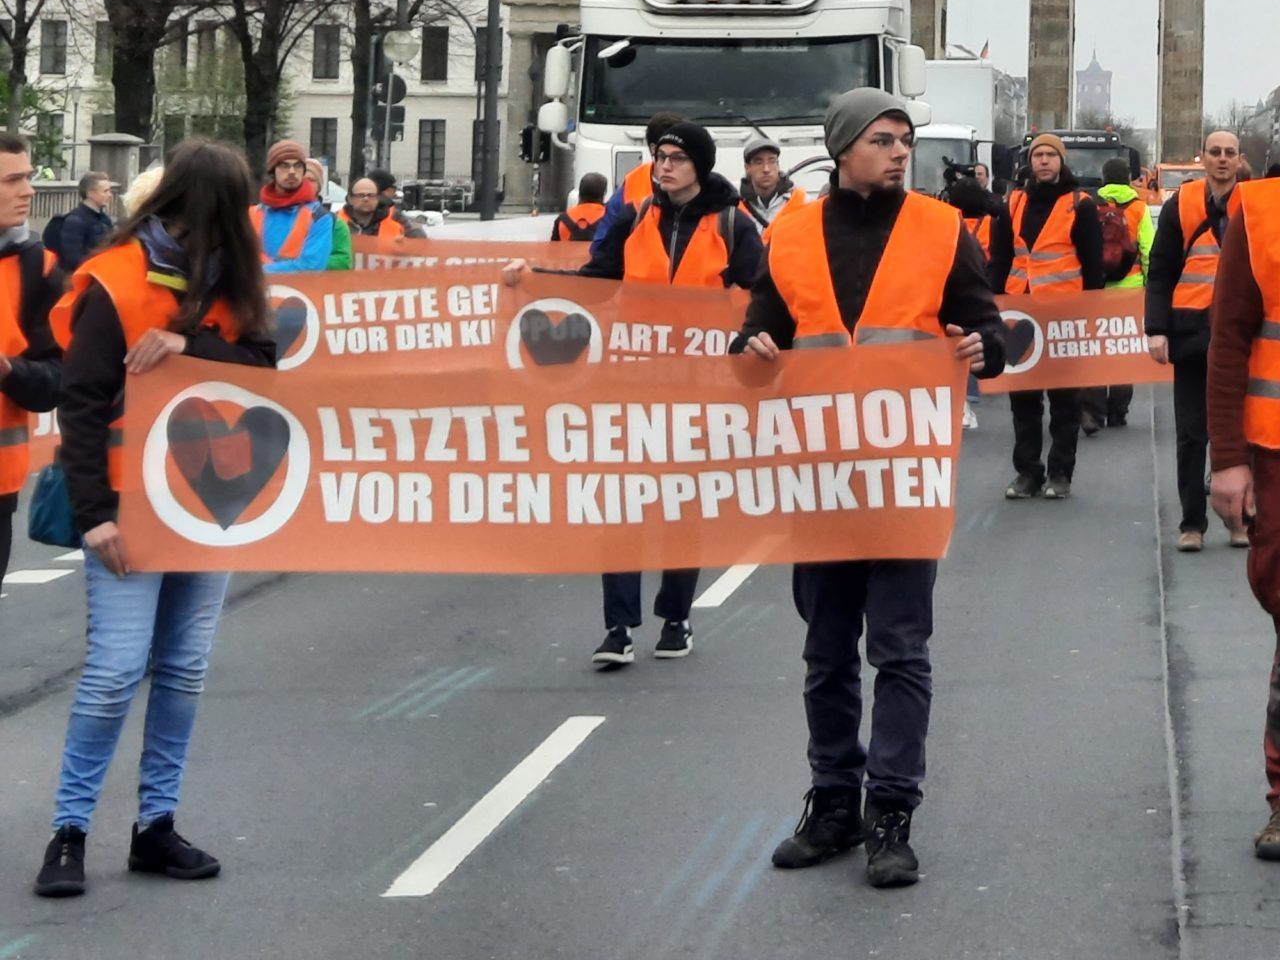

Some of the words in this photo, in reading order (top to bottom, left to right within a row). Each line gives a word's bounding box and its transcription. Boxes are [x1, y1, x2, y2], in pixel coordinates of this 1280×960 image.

[324, 287, 440, 325] LETZTE
[325, 326, 389, 355] VOR
[395, 321, 453, 351] DEN
[460, 319, 496, 347] KI
[608, 322, 677, 354] ART.
[1047, 319, 1092, 340] ART.
[1095, 315, 1138, 337] 20A
[1048, 339, 1102, 359] LEBEN
[317, 404, 530, 462] LETZTE
[545, 386, 952, 463] GENERATION
[319, 471, 433, 523] VOR
[449, 472, 551, 524] DEN
[565, 456, 952, 524] KIPPPUNKTEN
